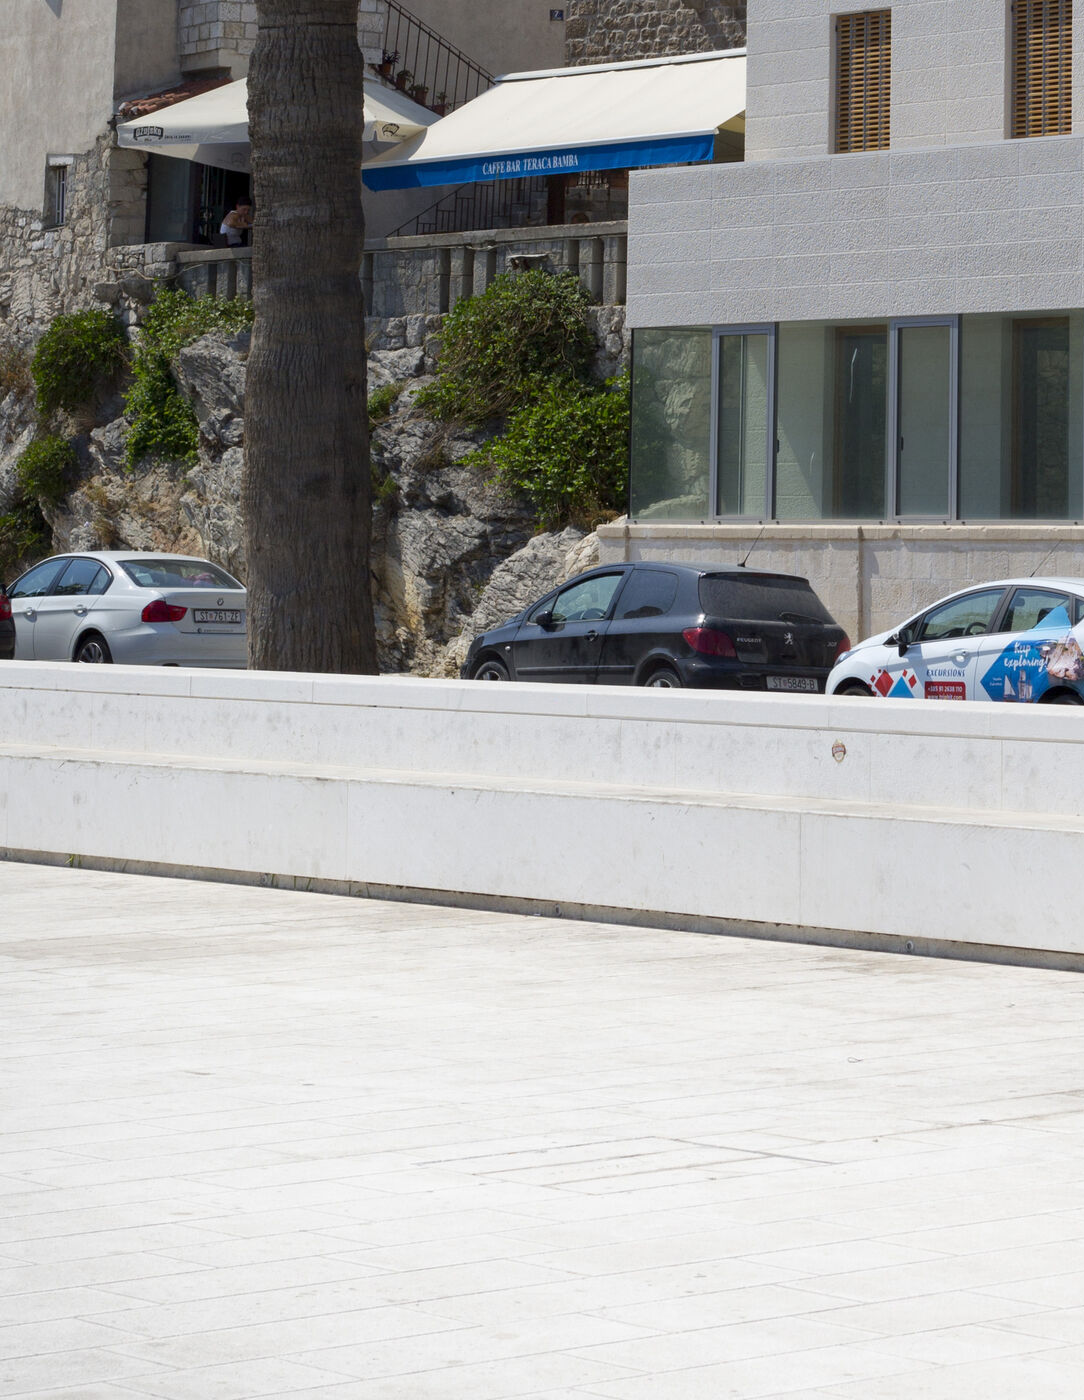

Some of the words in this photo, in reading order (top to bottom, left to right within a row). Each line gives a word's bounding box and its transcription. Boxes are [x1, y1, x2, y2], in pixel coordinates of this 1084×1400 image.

[482, 161, 506, 175] CAFFE
[506, 159, 521, 173] BAR
[523, 157, 552, 171] TERACA
[552, 154, 579, 169] BAMBA
[200, 611, 208, 620] ST
[1004, 655, 1049, 673] exploring!
[926, 669, 966, 677] EXCURSIONS
